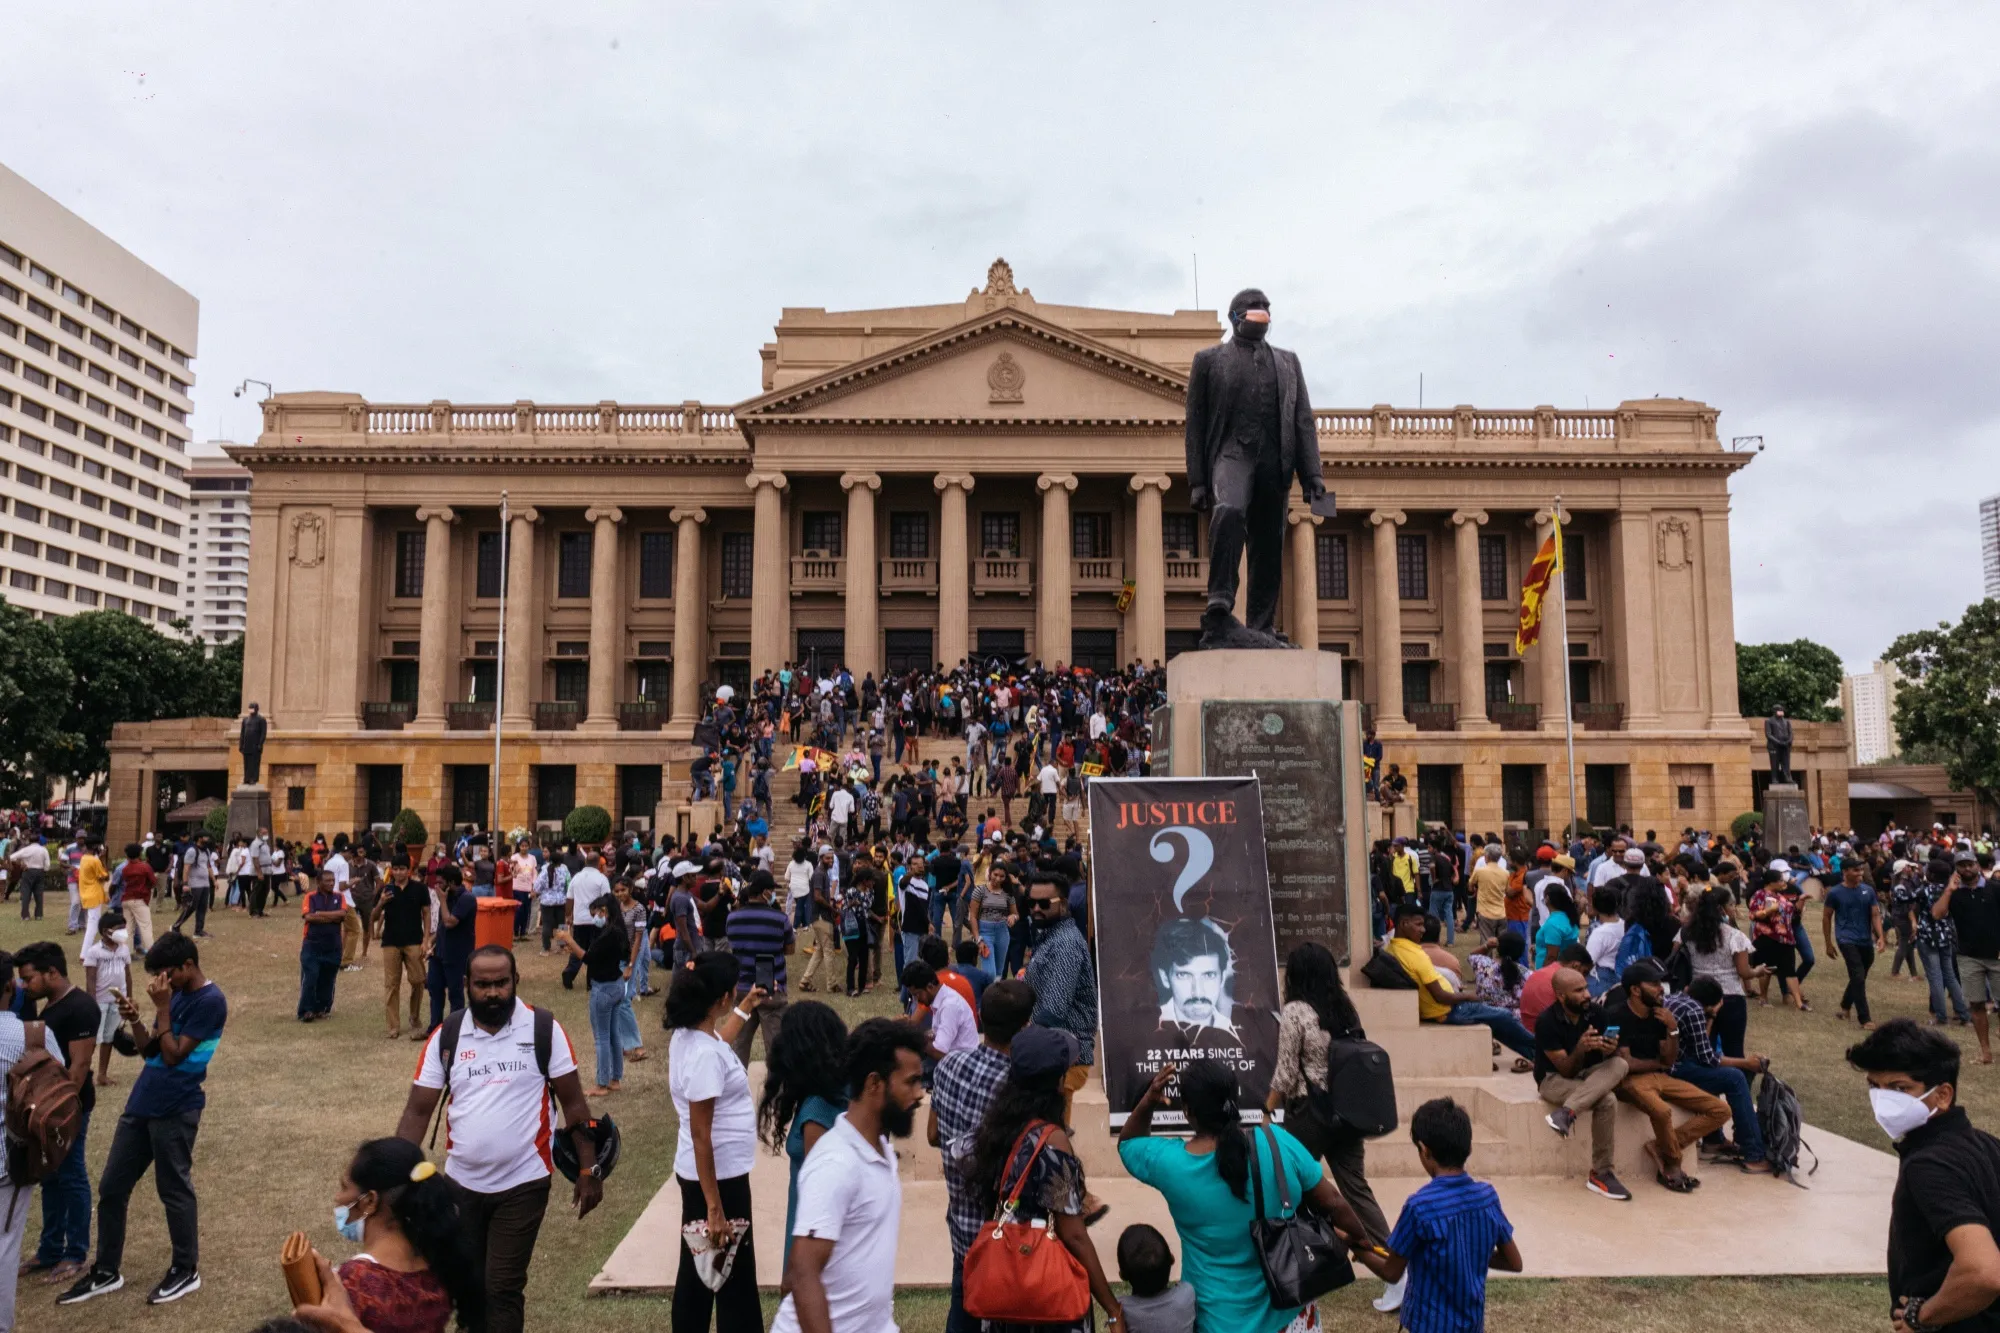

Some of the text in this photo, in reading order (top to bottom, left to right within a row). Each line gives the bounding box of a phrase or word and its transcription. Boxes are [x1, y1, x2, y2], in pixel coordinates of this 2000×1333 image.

[1116, 800, 1237, 830] JUSTICE
[460, 1049, 476, 1061] 95
[1147, 1047, 1243, 1060] 22 YEARS SINCE
[466, 1060, 528, 1081] Jack Wills
[1135, 1061, 1160, 1073] THE
[1238, 1060, 1256, 1071] OF
